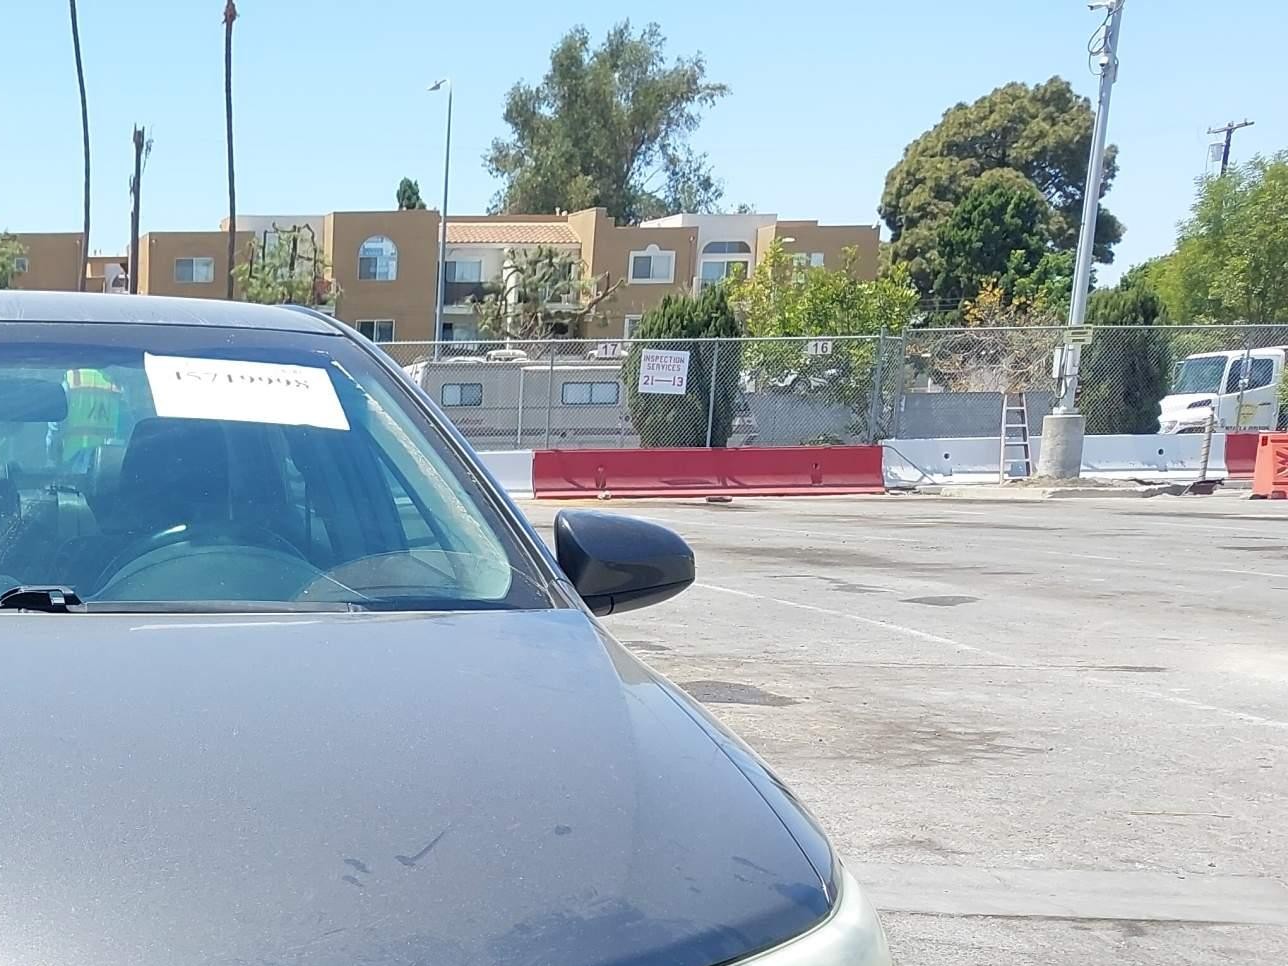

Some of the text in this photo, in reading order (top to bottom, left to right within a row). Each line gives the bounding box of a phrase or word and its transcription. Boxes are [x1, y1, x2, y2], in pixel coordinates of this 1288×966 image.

[602, 343, 618, 356] 17
[812, 342, 829, 354] 16
[643, 354, 685, 364] INSPECTION
[647, 362, 681, 372] SERVICES
